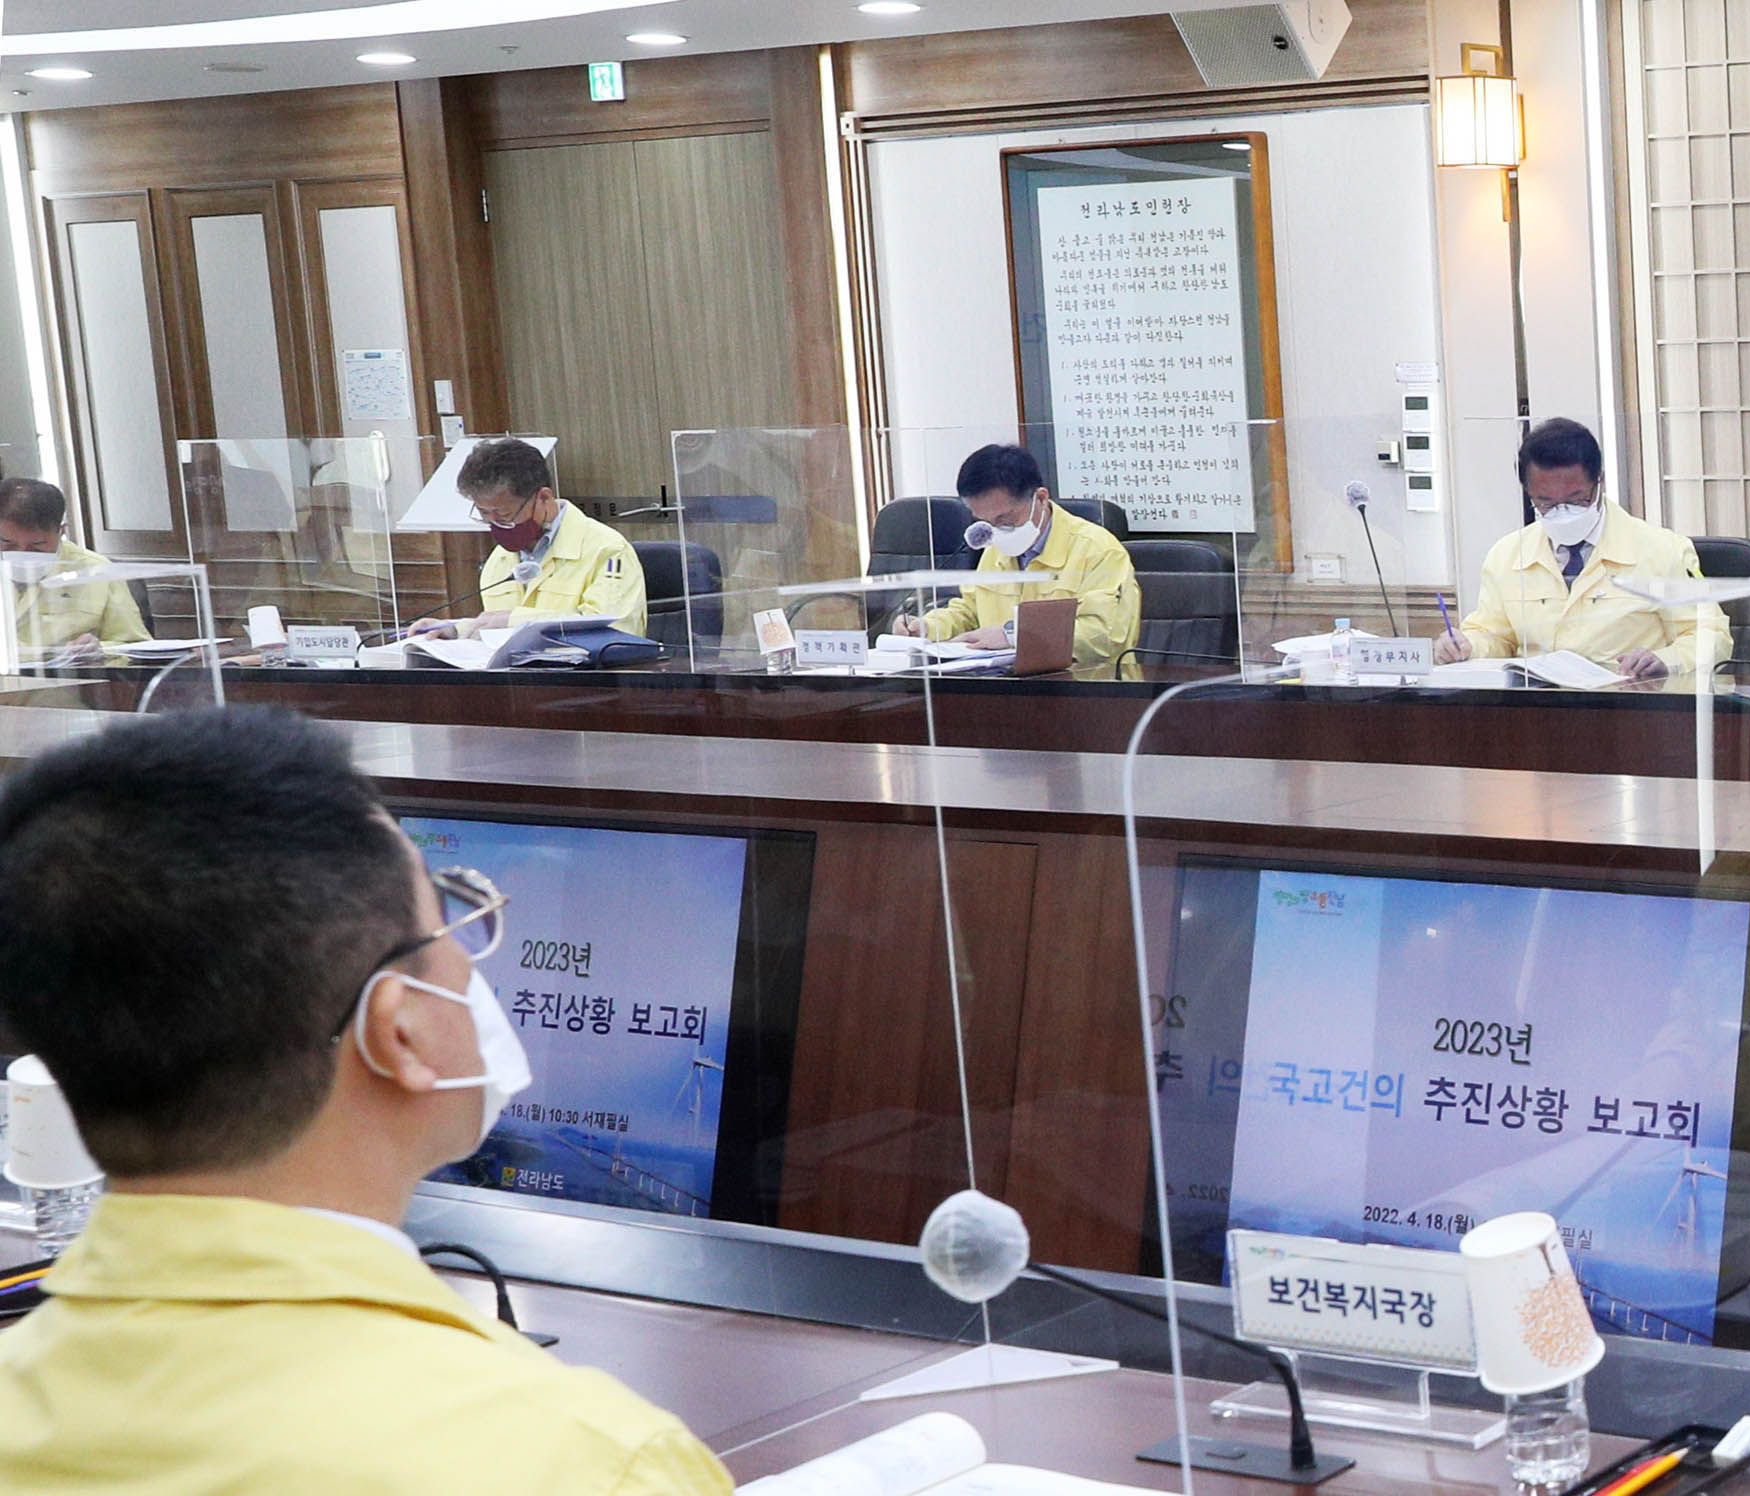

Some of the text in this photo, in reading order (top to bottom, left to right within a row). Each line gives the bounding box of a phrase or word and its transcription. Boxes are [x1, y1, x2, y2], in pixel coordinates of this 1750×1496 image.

[519, 939, 592, 978] 2023년
[511, 988, 708, 1046] 추진상황 보고회
[1433, 1017, 1534, 1067] 2023년
[1267, 1061, 1405, 1119] 국고건의
[1423, 1077, 1570, 1134] 추진상황
[1587, 1094, 1701, 1149] 보고회
[516, 1168, 564, 1191] 전라남도
[1363, 1205, 1402, 1226] 2022.
[1268, 1275, 1437, 1329] 보건복지국장
